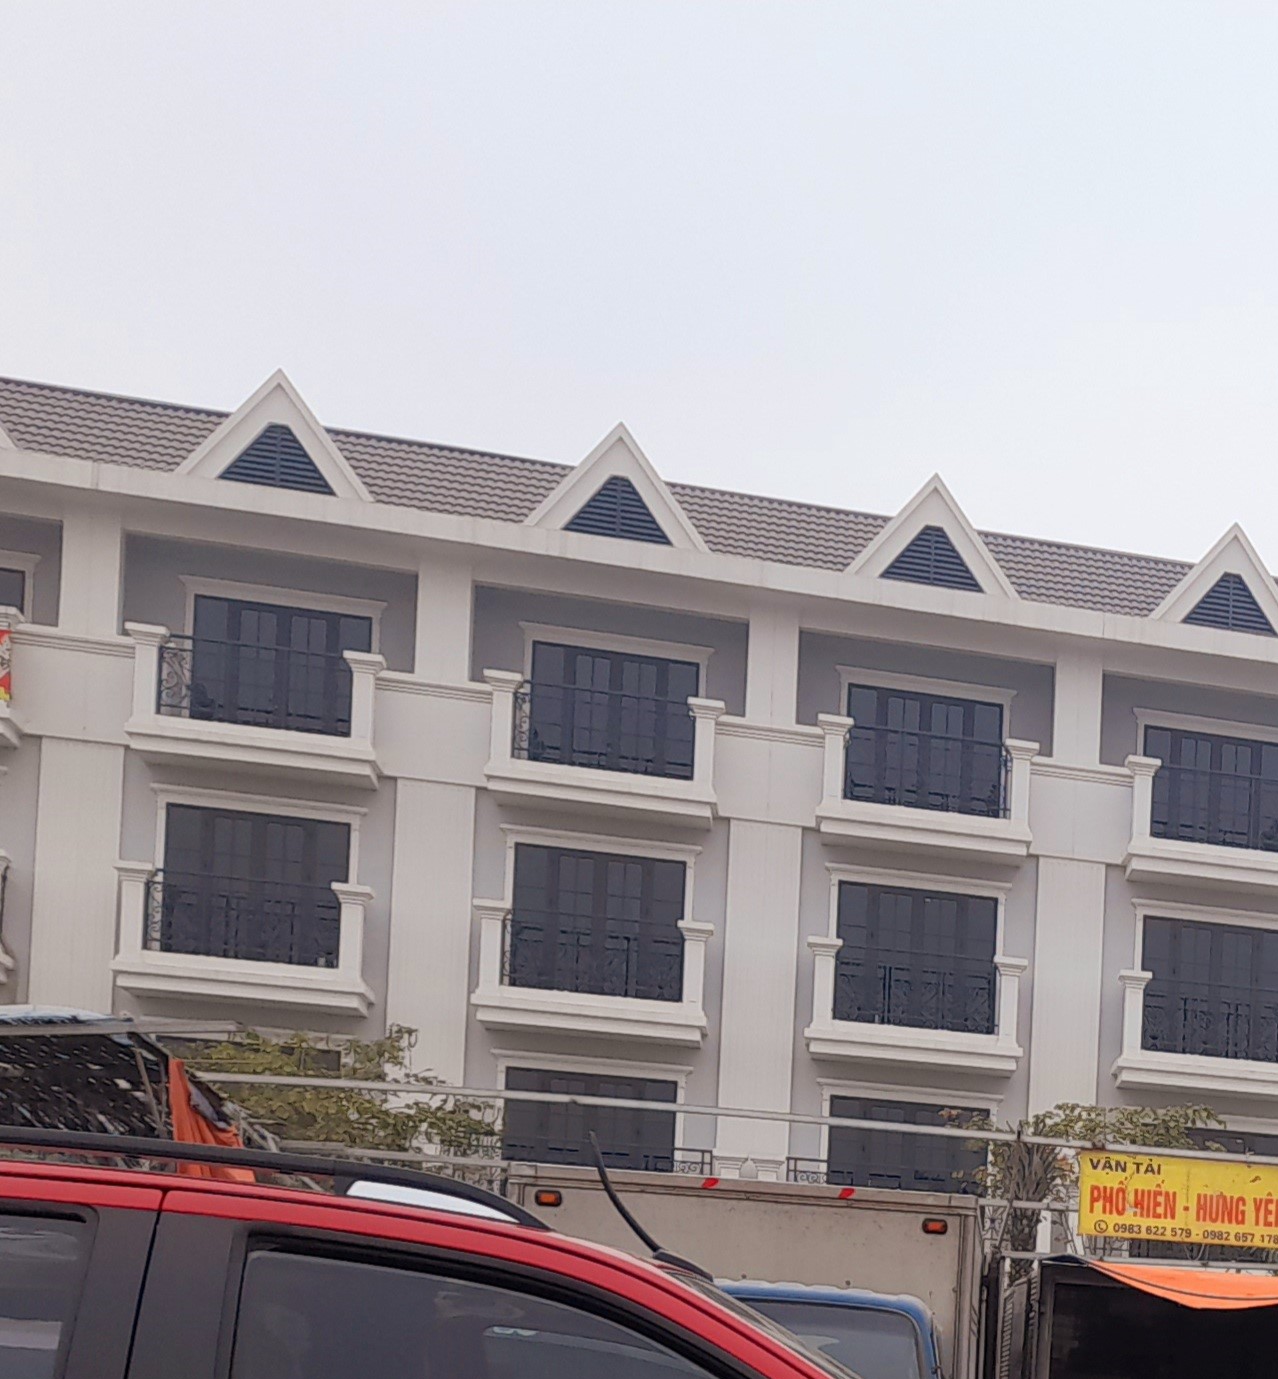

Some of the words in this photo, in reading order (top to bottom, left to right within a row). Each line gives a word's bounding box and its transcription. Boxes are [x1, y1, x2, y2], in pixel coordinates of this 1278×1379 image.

[1089, 1156, 1127, 1175] VẬN
[1133, 1158, 1162, 1176] TẢI
[1089, 1176, 1130, 1216] PHỐ
[1133, 1179, 1177, 1220] HIẾN
[1195, 1191, 1246, 1226] HƯNG
[1113, 1222, 1142, 1235] 0983
[1146, 1225, 1167, 1236] 622
[1170, 1227, 1192, 1238] 579
[1202, 1229, 1231, 1241] 0982
